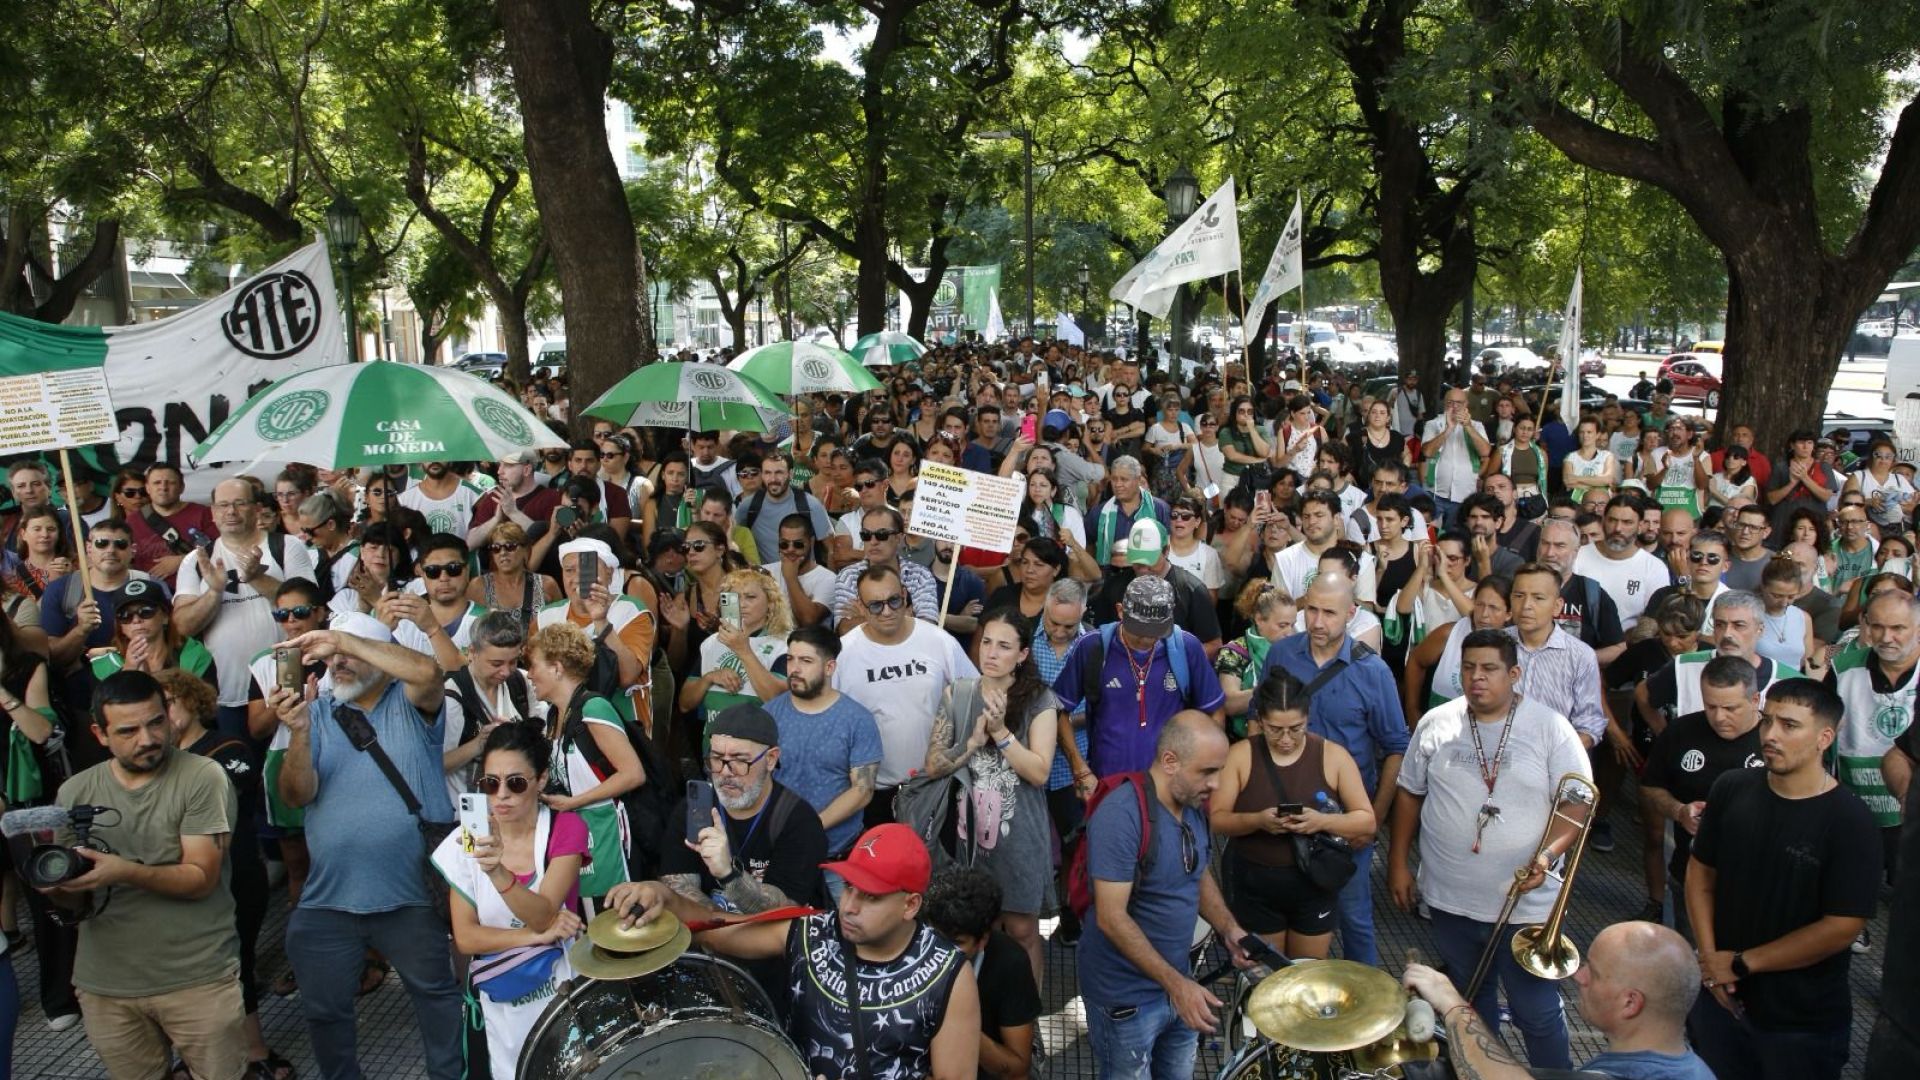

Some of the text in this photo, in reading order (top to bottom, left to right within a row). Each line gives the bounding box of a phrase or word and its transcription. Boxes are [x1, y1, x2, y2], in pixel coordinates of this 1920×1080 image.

[229, 271, 313, 352] ATE
[926, 313, 977, 327] APITAL
[376, 419, 422, 432] CASA
[388, 431, 416, 444] DE
[362, 441, 446, 456] MONEDA
[929, 466, 952, 475] CASA
[921, 472, 957, 484] MONEDA
[920, 496, 961, 509] SERVICIO
[867, 658, 927, 683] Levi's
[810, 940, 848, 996] Bestia
